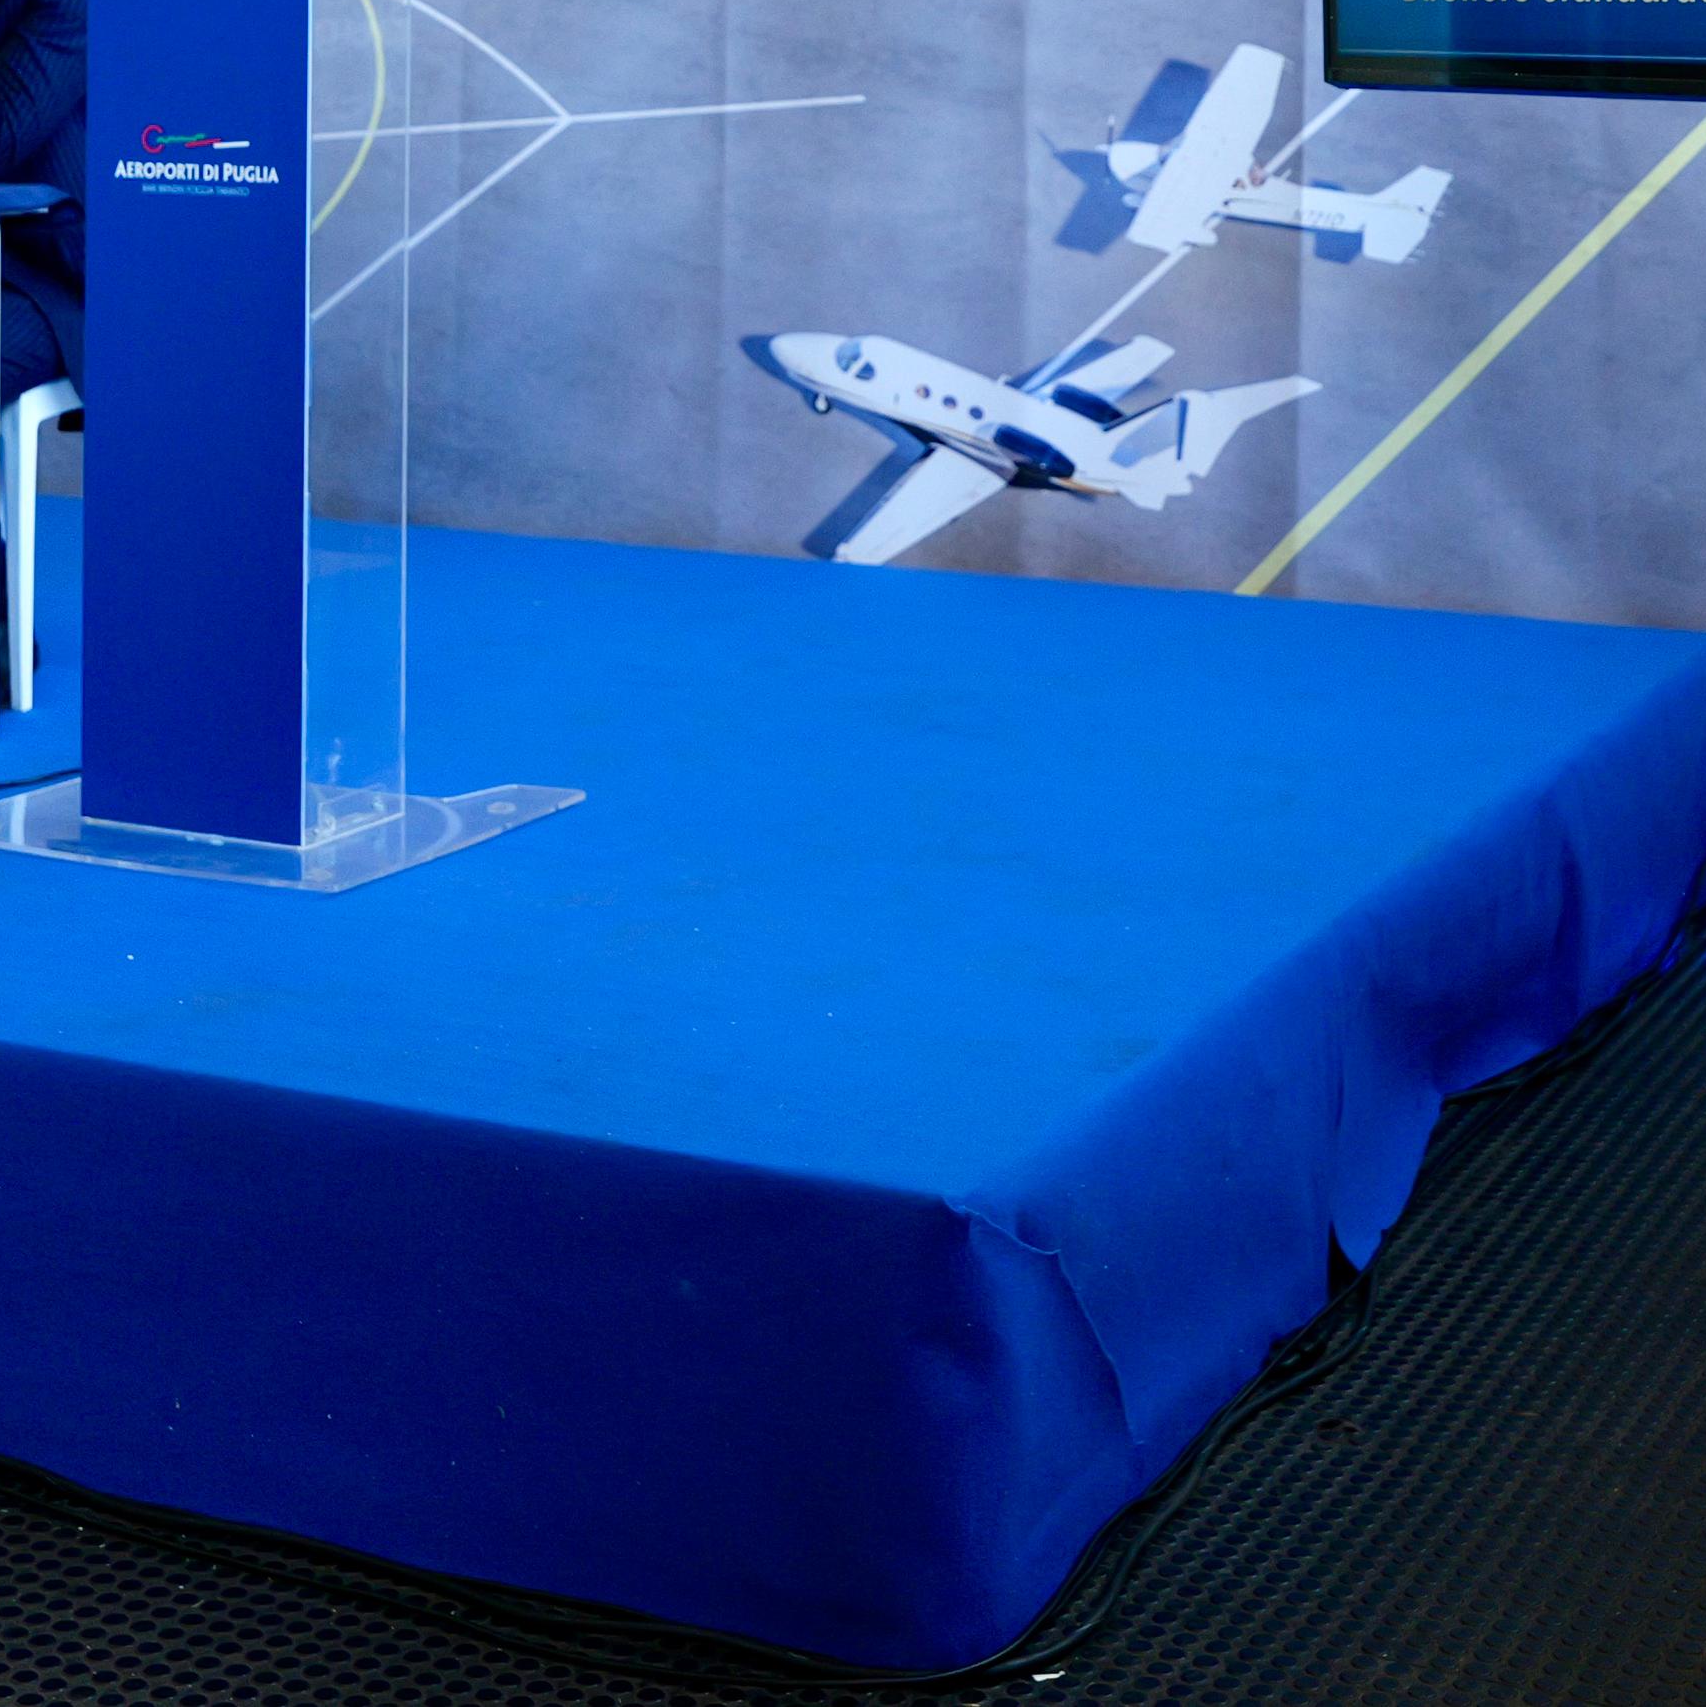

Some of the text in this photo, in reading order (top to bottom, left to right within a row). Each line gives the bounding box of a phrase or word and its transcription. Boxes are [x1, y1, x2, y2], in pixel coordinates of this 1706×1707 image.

[114, 159, 279, 183] AEROPORTI DI PUGLIA
